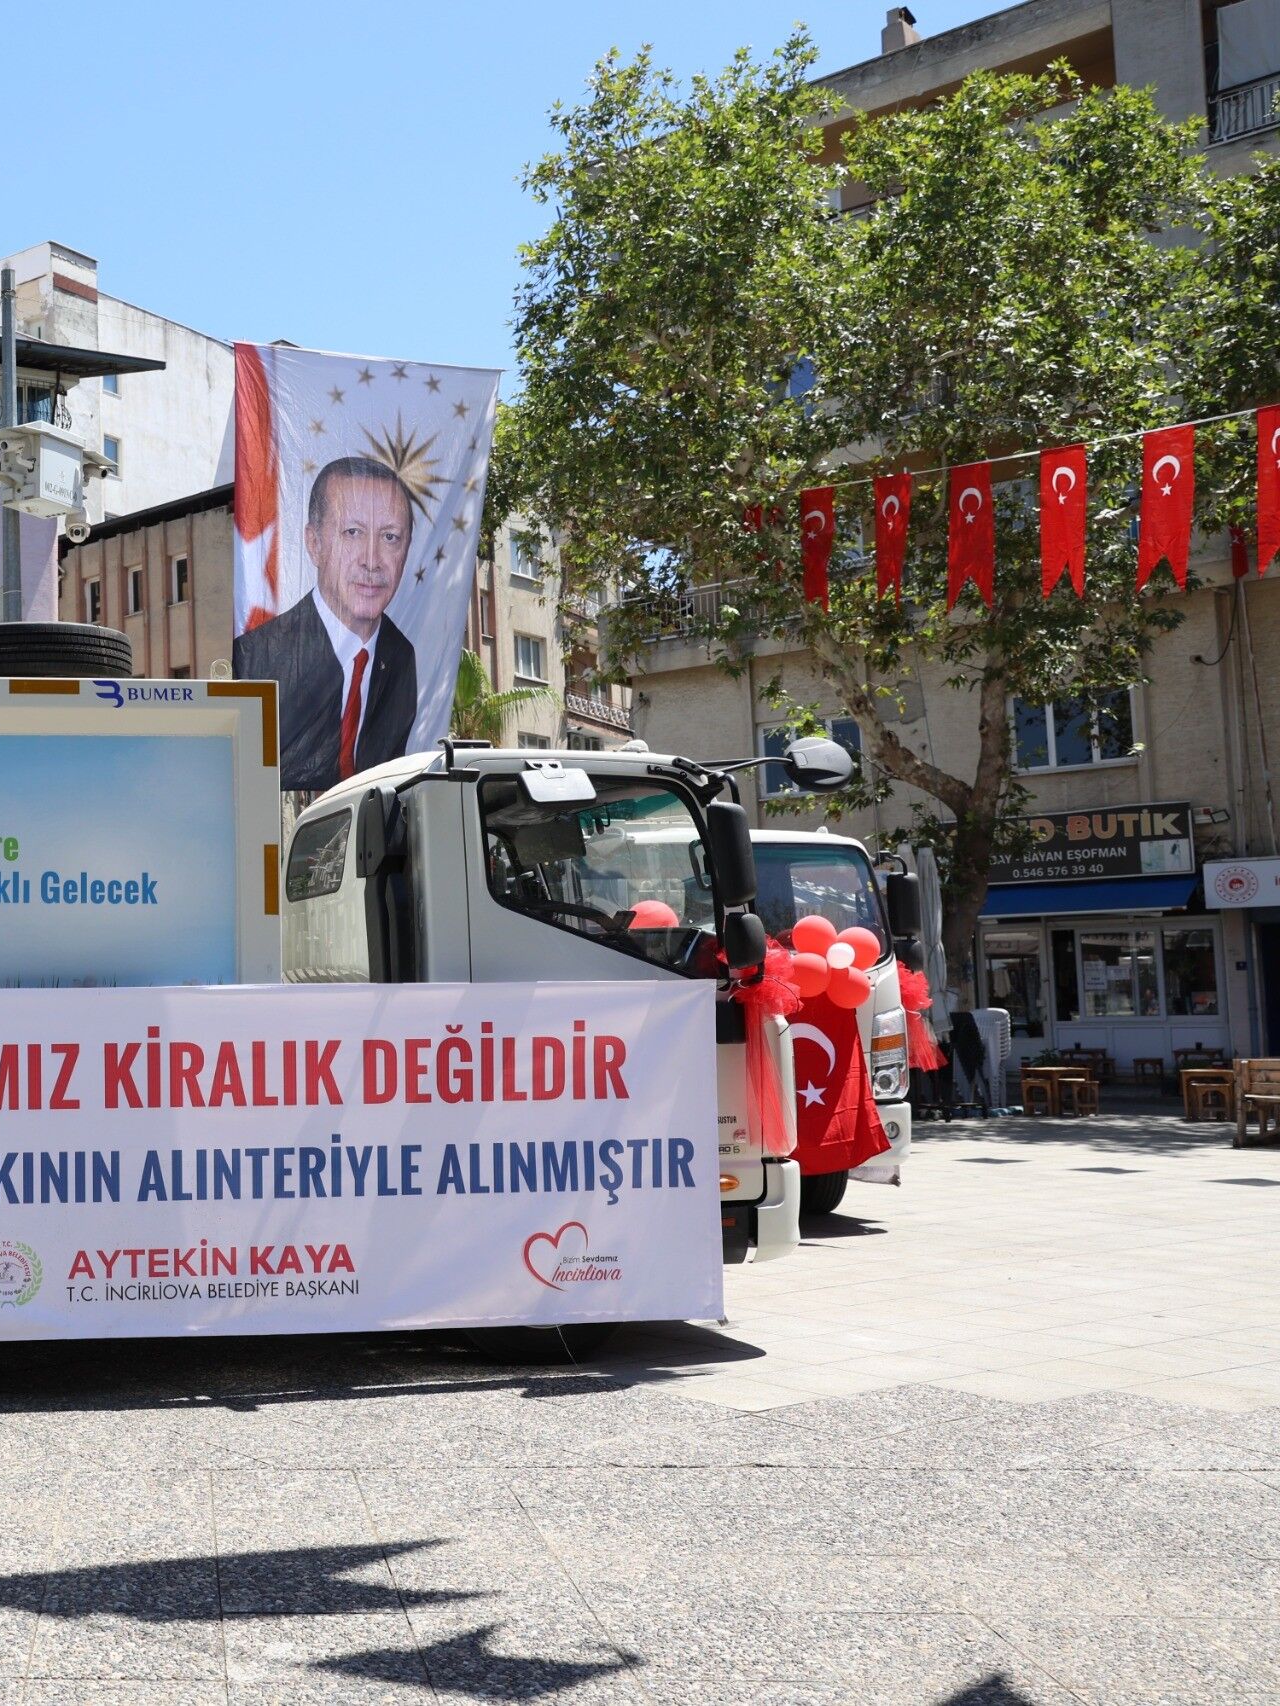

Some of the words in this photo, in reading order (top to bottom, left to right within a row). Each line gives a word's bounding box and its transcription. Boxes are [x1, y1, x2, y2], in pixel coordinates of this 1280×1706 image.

[127, 688, 194, 701] BUMER
[1066, 809, 1183, 841] BUTİK
[1023, 850, 1063, 863] BAYAN
[1067, 847, 1127, 862] EŞOFMAN
[1048, 866, 1068, 876] 576
[1072, 864, 1086, 875] 39
[1089, 863, 1104, 874] 40
[41, 871, 158, 904] Gelecek
[104, 1026, 343, 1109] KİRALIK
[363, 1020, 630, 1104] DEĞİLDİR
[137, 1134, 422, 1202] ALINTERİYLE
[437, 1138, 696, 1205] ALINMIŞTIR
[68, 1239, 237, 1280] AYTEKİN
[250, 1244, 355, 1275] KAYA
[562, 1256, 580, 1264] Bizim
[582, 1254, 619, 1263] Sevdamız
[551, 1262, 622, 1282] İncirliova
[67, 1286, 98, 1302] T.C.
[105, 1282, 201, 1301] İNCİRLİOVA
[208, 1280, 279, 1299] BELEDİYE
[286, 1279, 359, 1299] BAŞKANI
